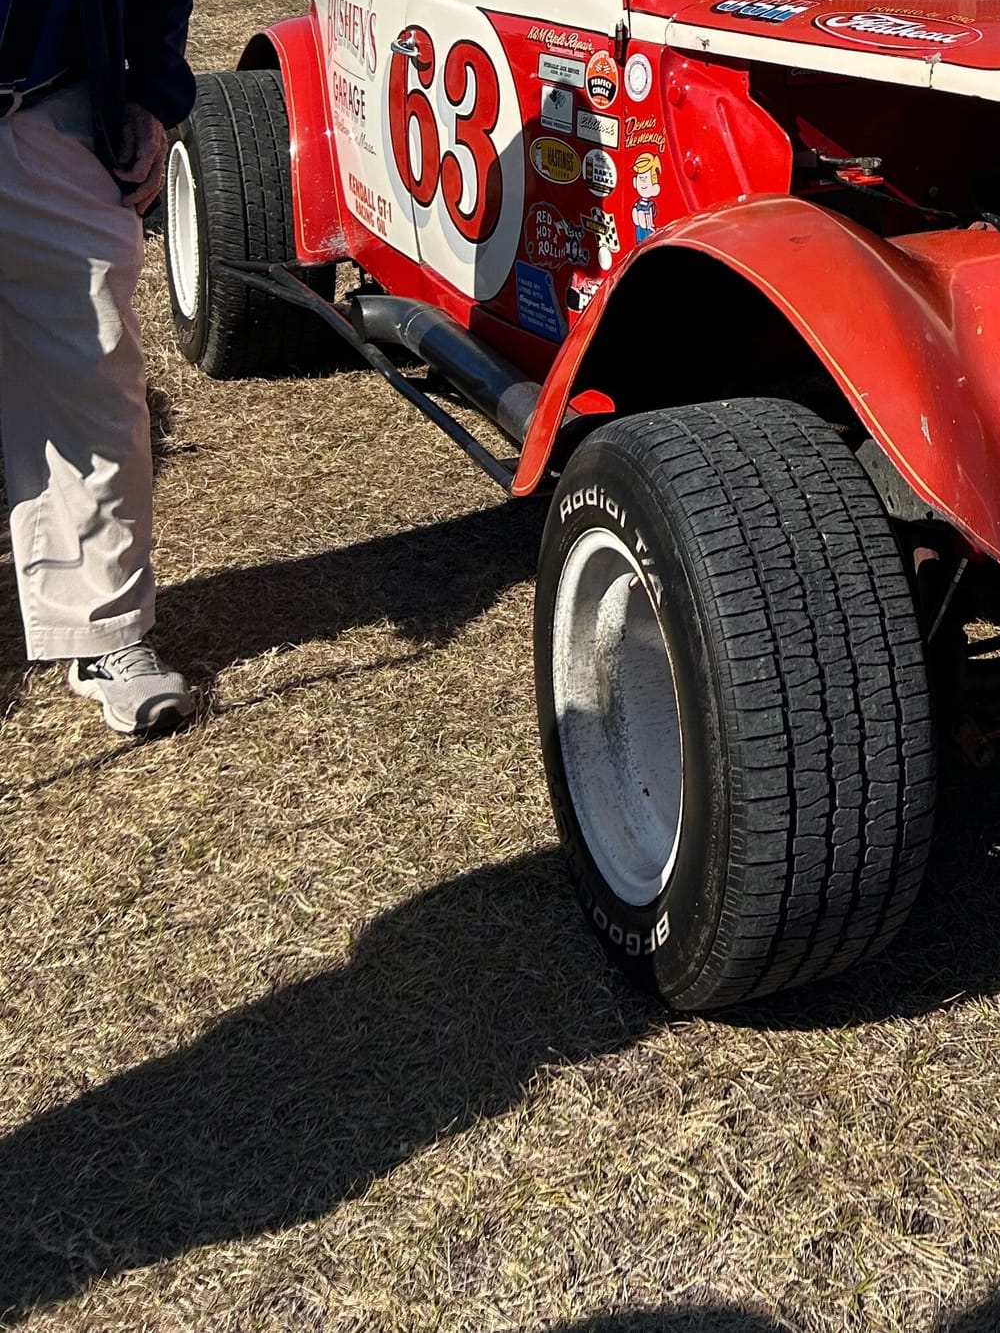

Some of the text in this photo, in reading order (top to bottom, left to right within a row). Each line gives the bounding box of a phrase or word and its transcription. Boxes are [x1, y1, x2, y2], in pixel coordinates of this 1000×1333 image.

[827, 12, 971, 44] Flathead
[333, 71, 367, 121] GARAGE
[388, 25, 503, 244] 63
[624, 114, 657, 135] Dennis
[348, 170, 393, 224] KENDALL GT-1
[376, 216, 388, 238] OIL
[536, 210, 553, 226] RED
[536, 226, 552, 240] HOT
[559, 484, 627, 528] Radial
